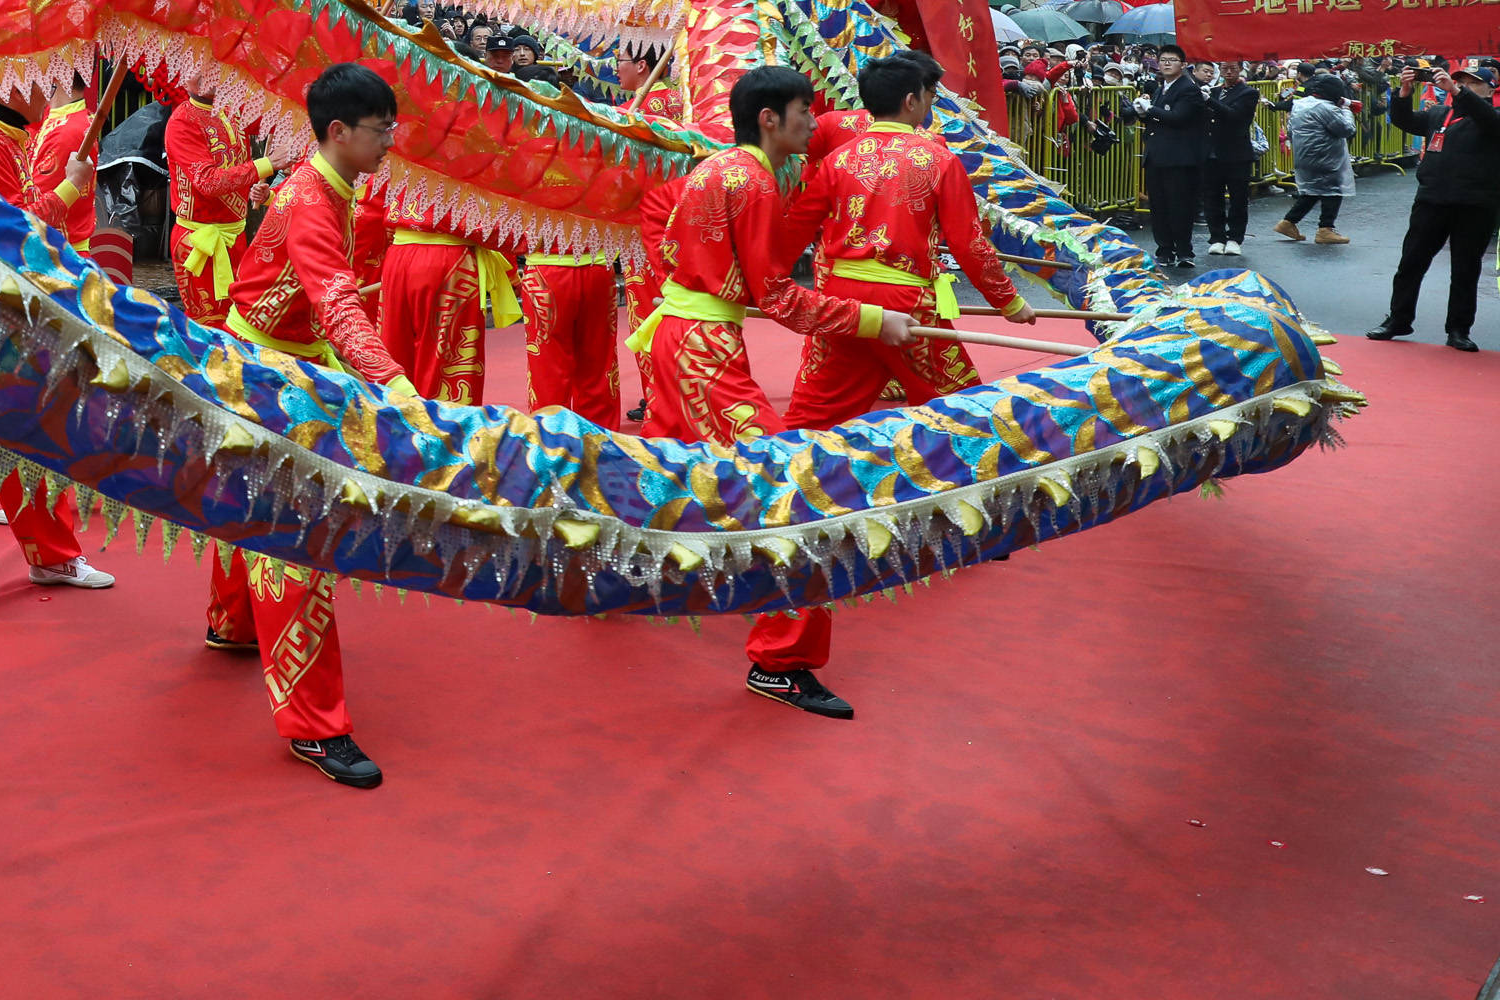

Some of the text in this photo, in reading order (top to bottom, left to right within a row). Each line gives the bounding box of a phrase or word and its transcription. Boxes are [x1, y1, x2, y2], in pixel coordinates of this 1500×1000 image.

[1347, 38, 1396, 59] 闹元宵
[855, 159, 899, 180] 三林
[844, 222, 892, 248] 忠义
